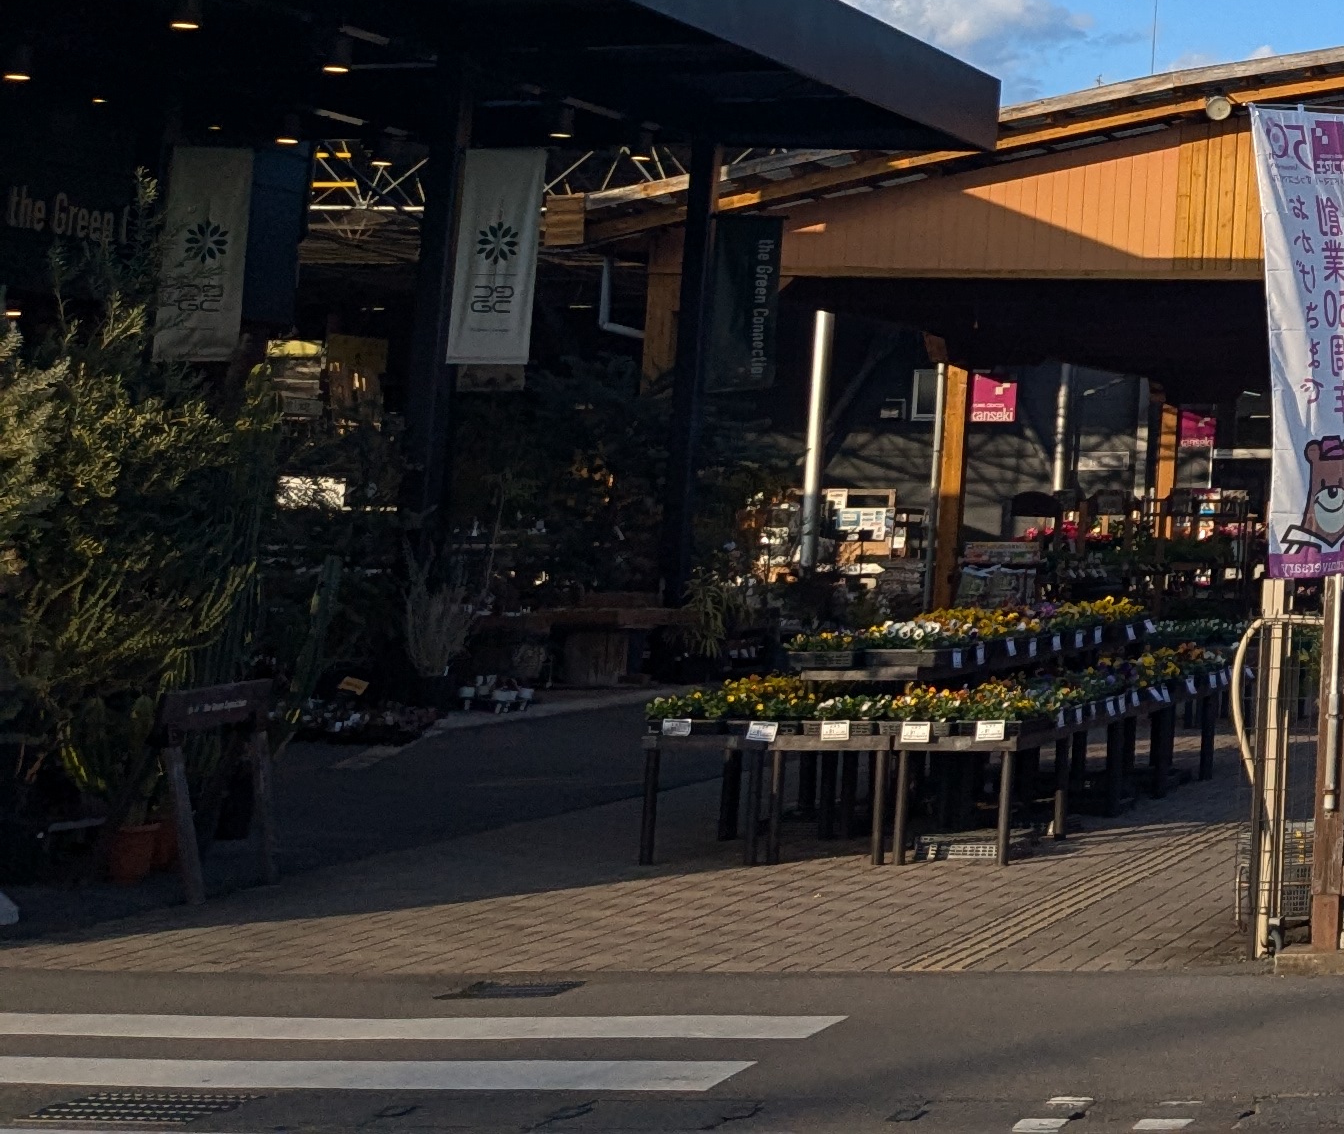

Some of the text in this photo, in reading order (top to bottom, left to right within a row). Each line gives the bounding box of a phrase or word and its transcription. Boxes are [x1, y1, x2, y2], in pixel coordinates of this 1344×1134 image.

[7, 185, 46, 231] the
[757, 239, 774, 261] the
[754, 265, 773, 303] Green
